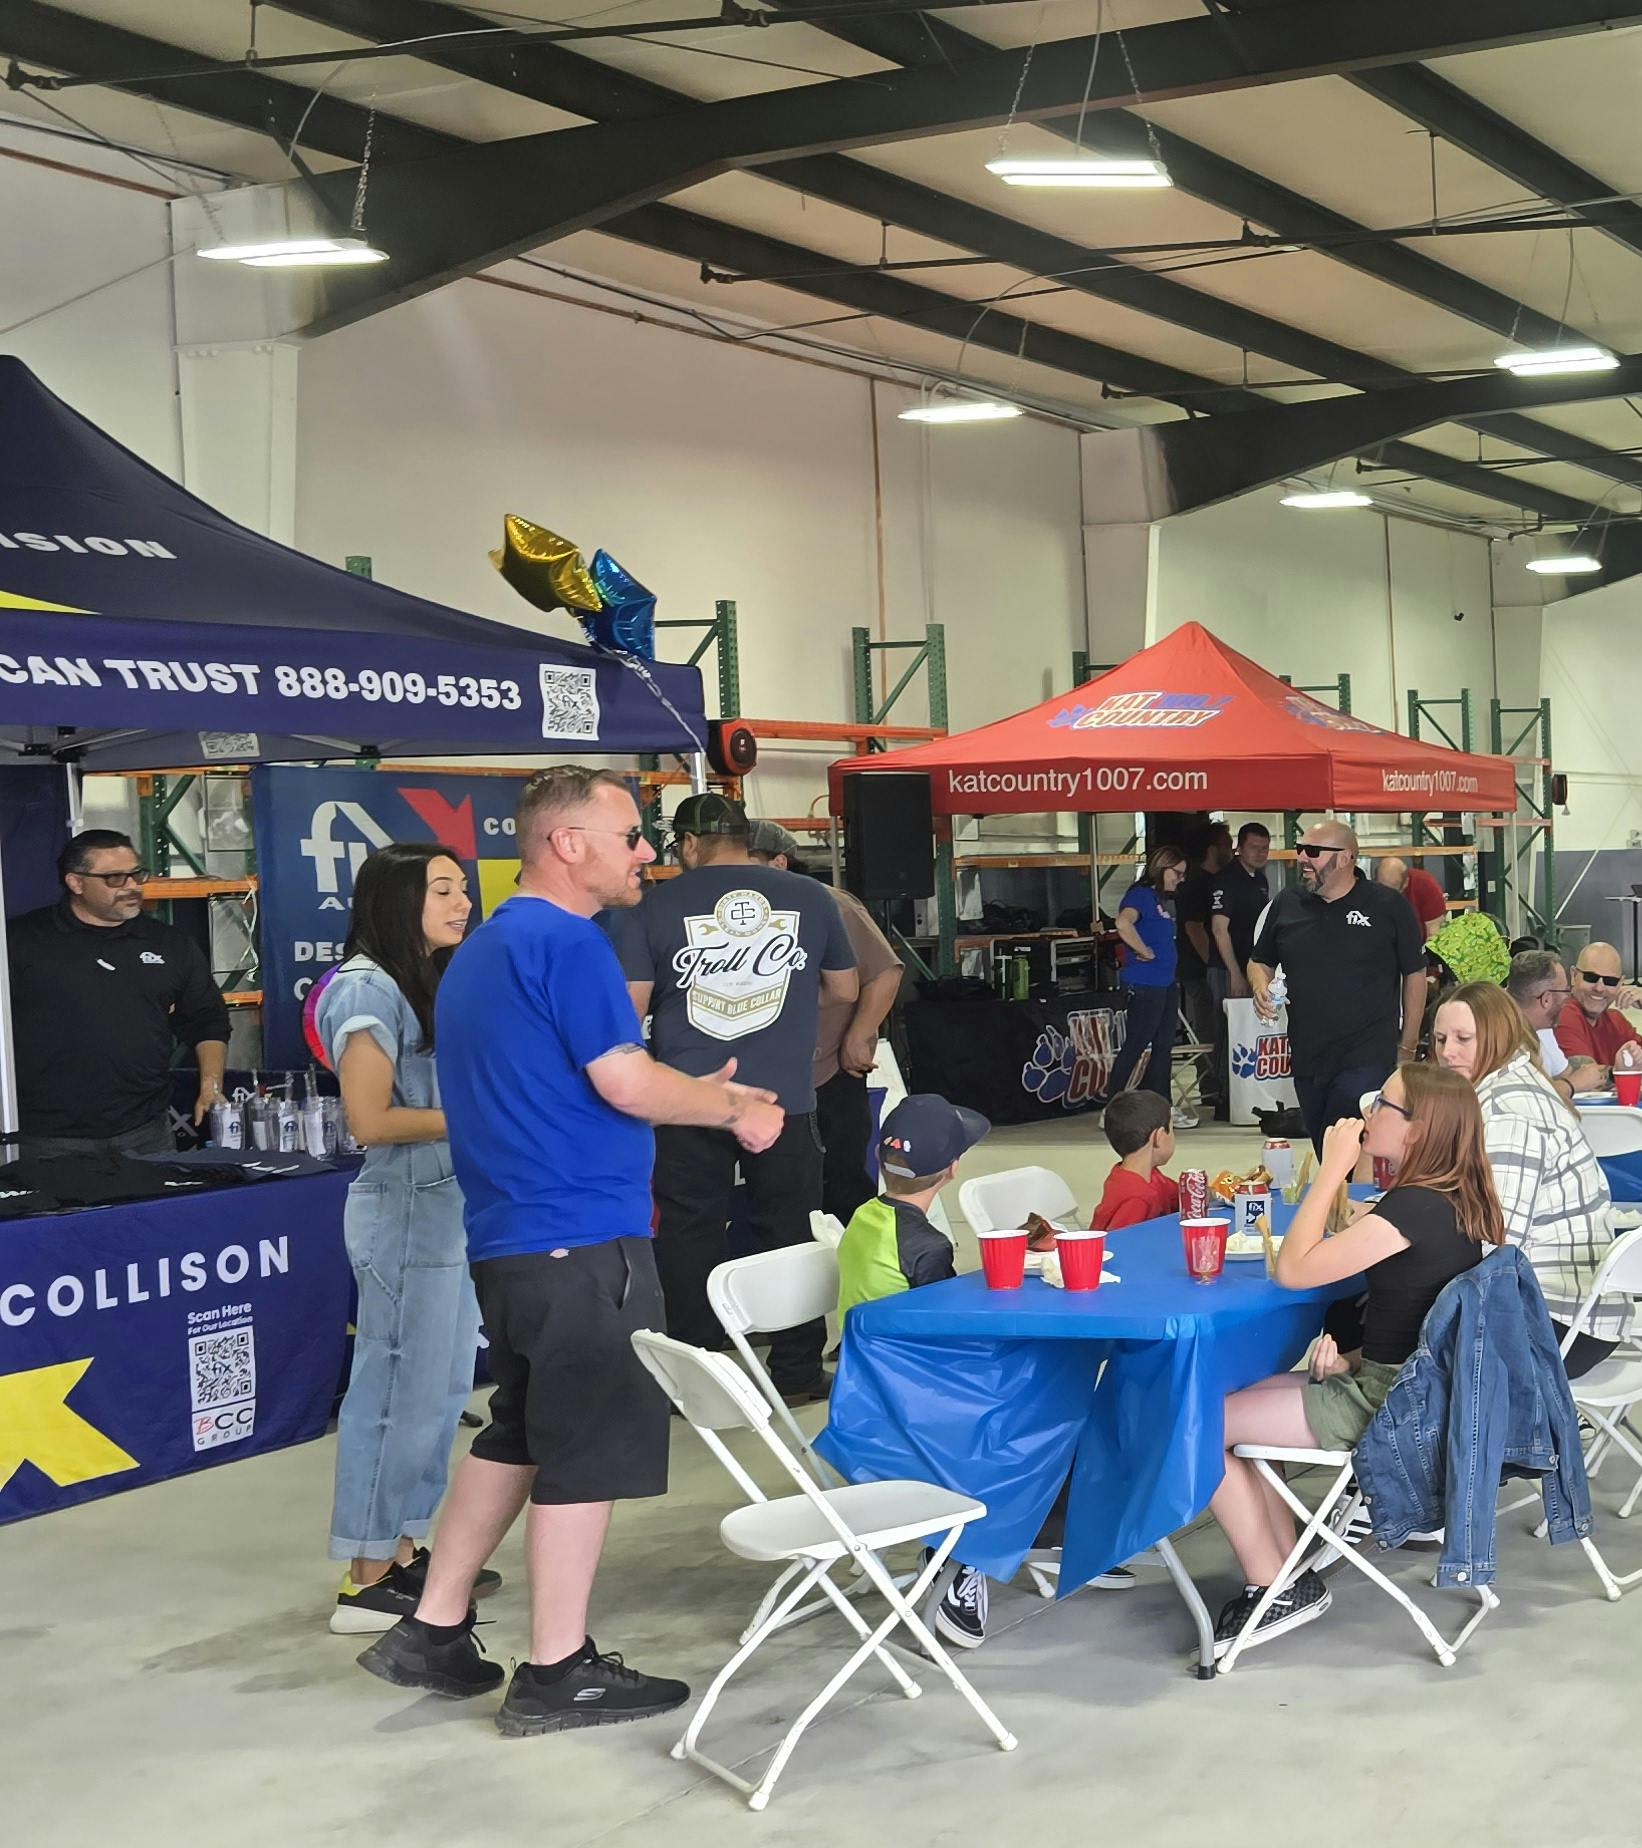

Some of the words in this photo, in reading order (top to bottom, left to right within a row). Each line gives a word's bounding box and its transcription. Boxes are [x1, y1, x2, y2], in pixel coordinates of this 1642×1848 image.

[0, 654, 102, 687] CAN
[103, 659, 261, 696] TRUST
[274, 665, 522, 710] 888-909-5353
[1073, 709, 1221, 729] COUNTRY
[948, 767, 1209, 798] katcountry1007.com
[1382, 769, 1478, 797] katcountry1007.com
[676, 942, 751, 988] Troll
[692, 990, 726, 1012] SUPPORT
[727, 1000, 750, 1015] BLUE
[750, 988, 782, 1008] COLLAR
[0, 1236, 289, 1327] COLLISON
[187, 1309, 220, 1325] Scan
[221, 1302, 252, 1318] Here
[194, 1407, 253, 1436] BCC
